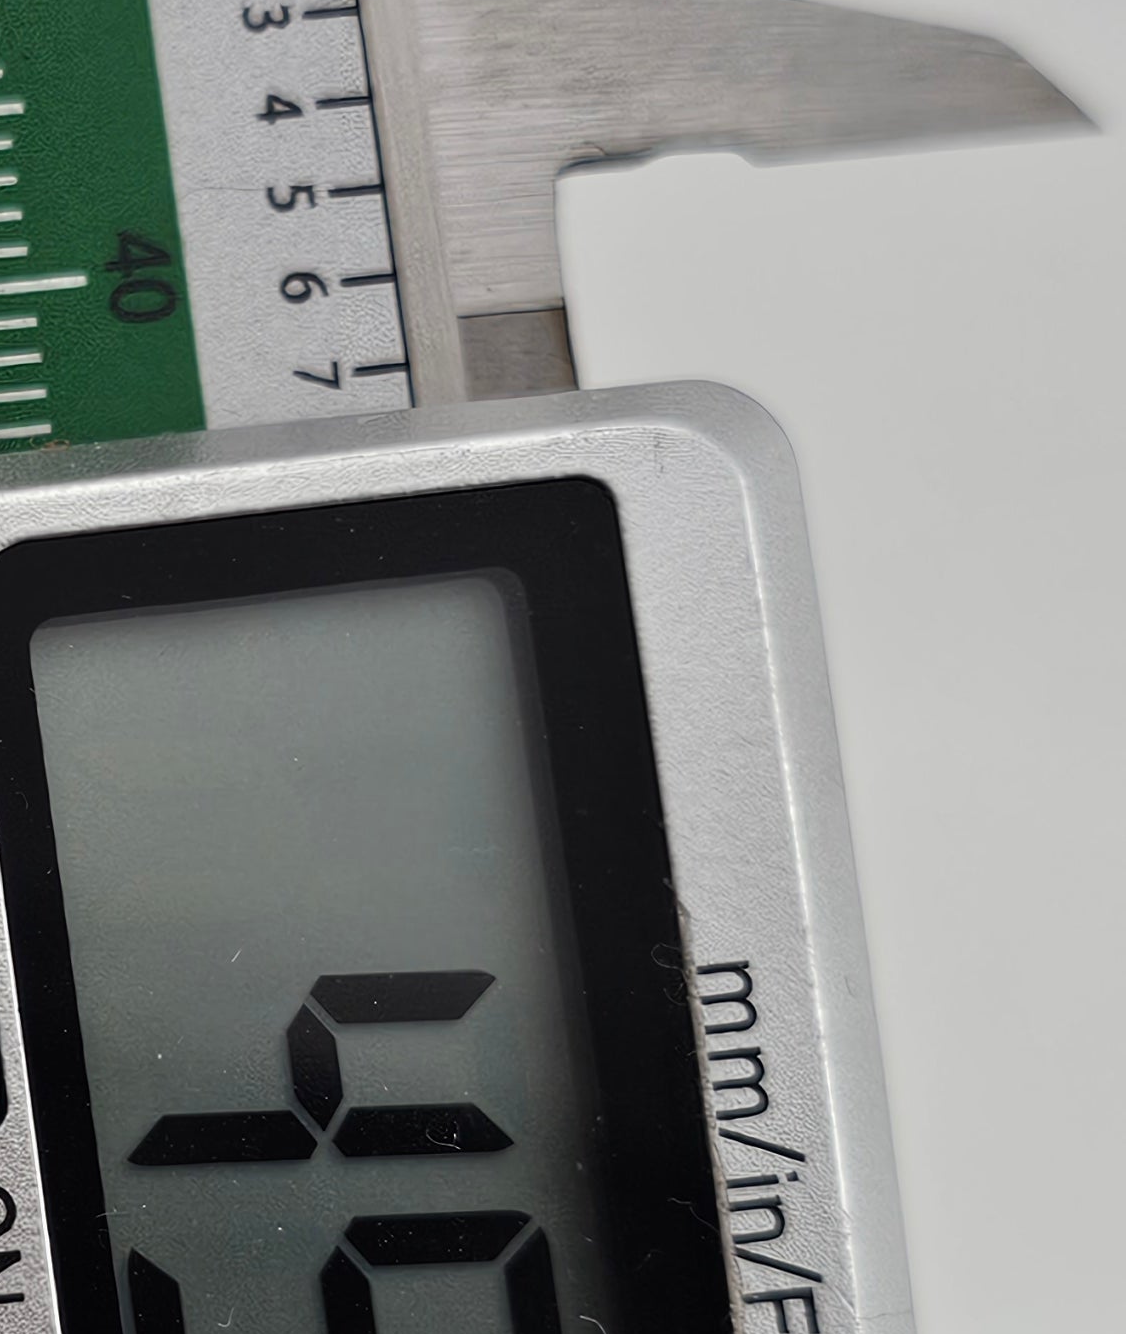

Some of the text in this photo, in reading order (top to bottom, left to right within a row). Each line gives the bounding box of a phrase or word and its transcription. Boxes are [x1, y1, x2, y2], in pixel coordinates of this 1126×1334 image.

[241, 3, 291, 34] 3
[255, 93, 304, 127] 4
[265, 184, 318, 213] 5
[104, 229, 182, 324] 40
[278, 270, 330, 305] 6
[292, 360, 341, 391] 7
